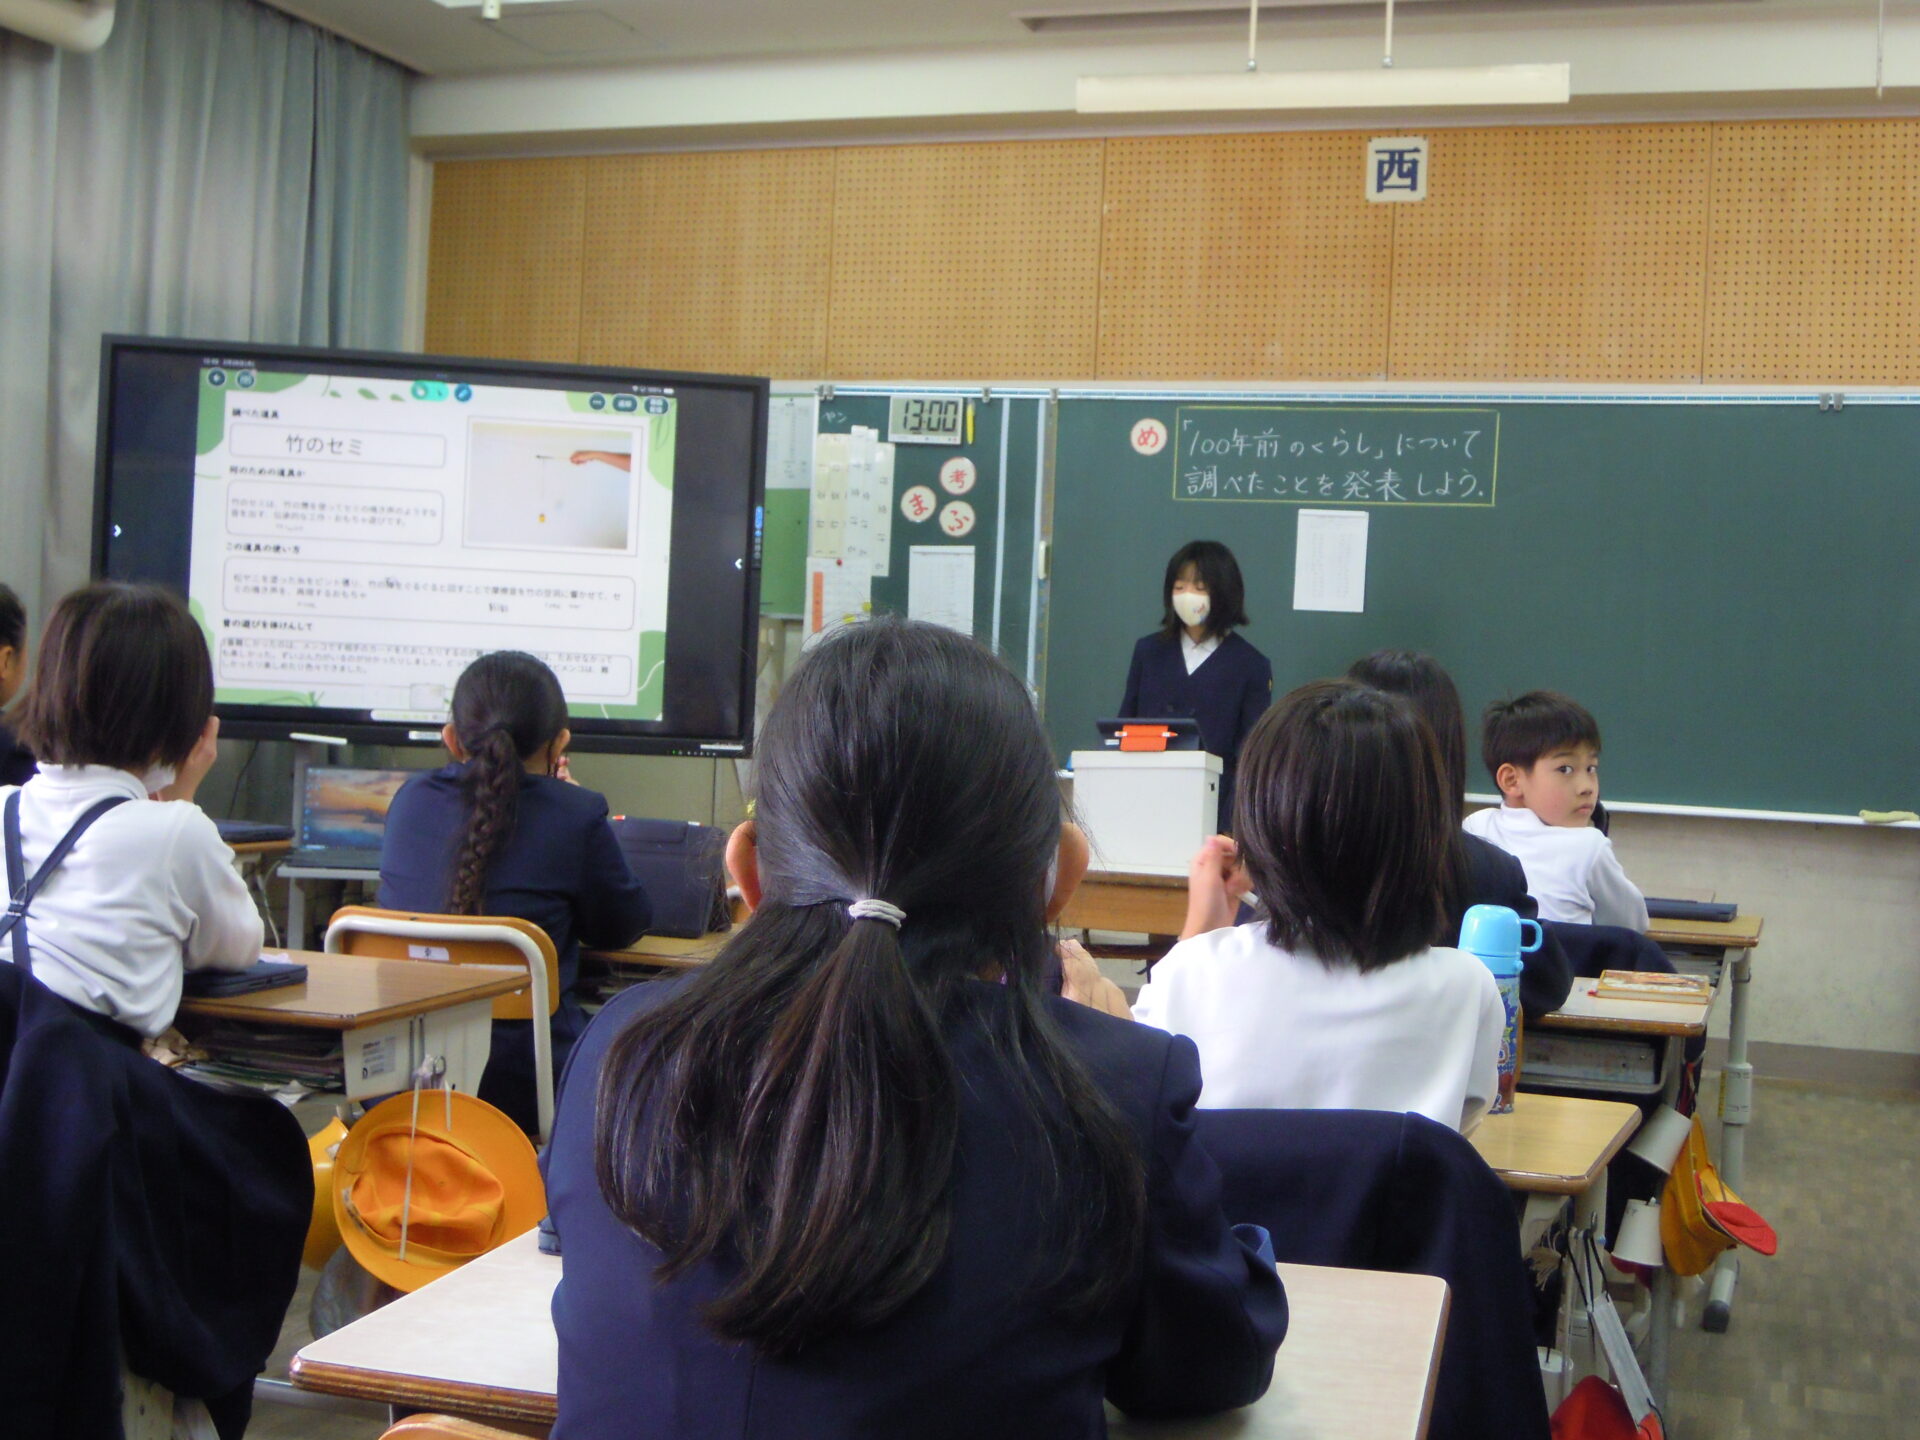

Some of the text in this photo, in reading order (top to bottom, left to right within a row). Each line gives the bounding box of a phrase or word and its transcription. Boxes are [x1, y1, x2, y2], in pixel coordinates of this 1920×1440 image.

[1375, 147, 1422, 193] 西
[902, 400, 958, 433] 13:00
[286, 434, 363, 456] 竹のセミ
[1136, 427, 1160, 448] め
[1183, 418, 1483, 460] 「100年前のくらし」について
[948, 469, 969, 490] 考
[908, 493, 930, 515] ま
[947, 508, 971, 533] ふ
